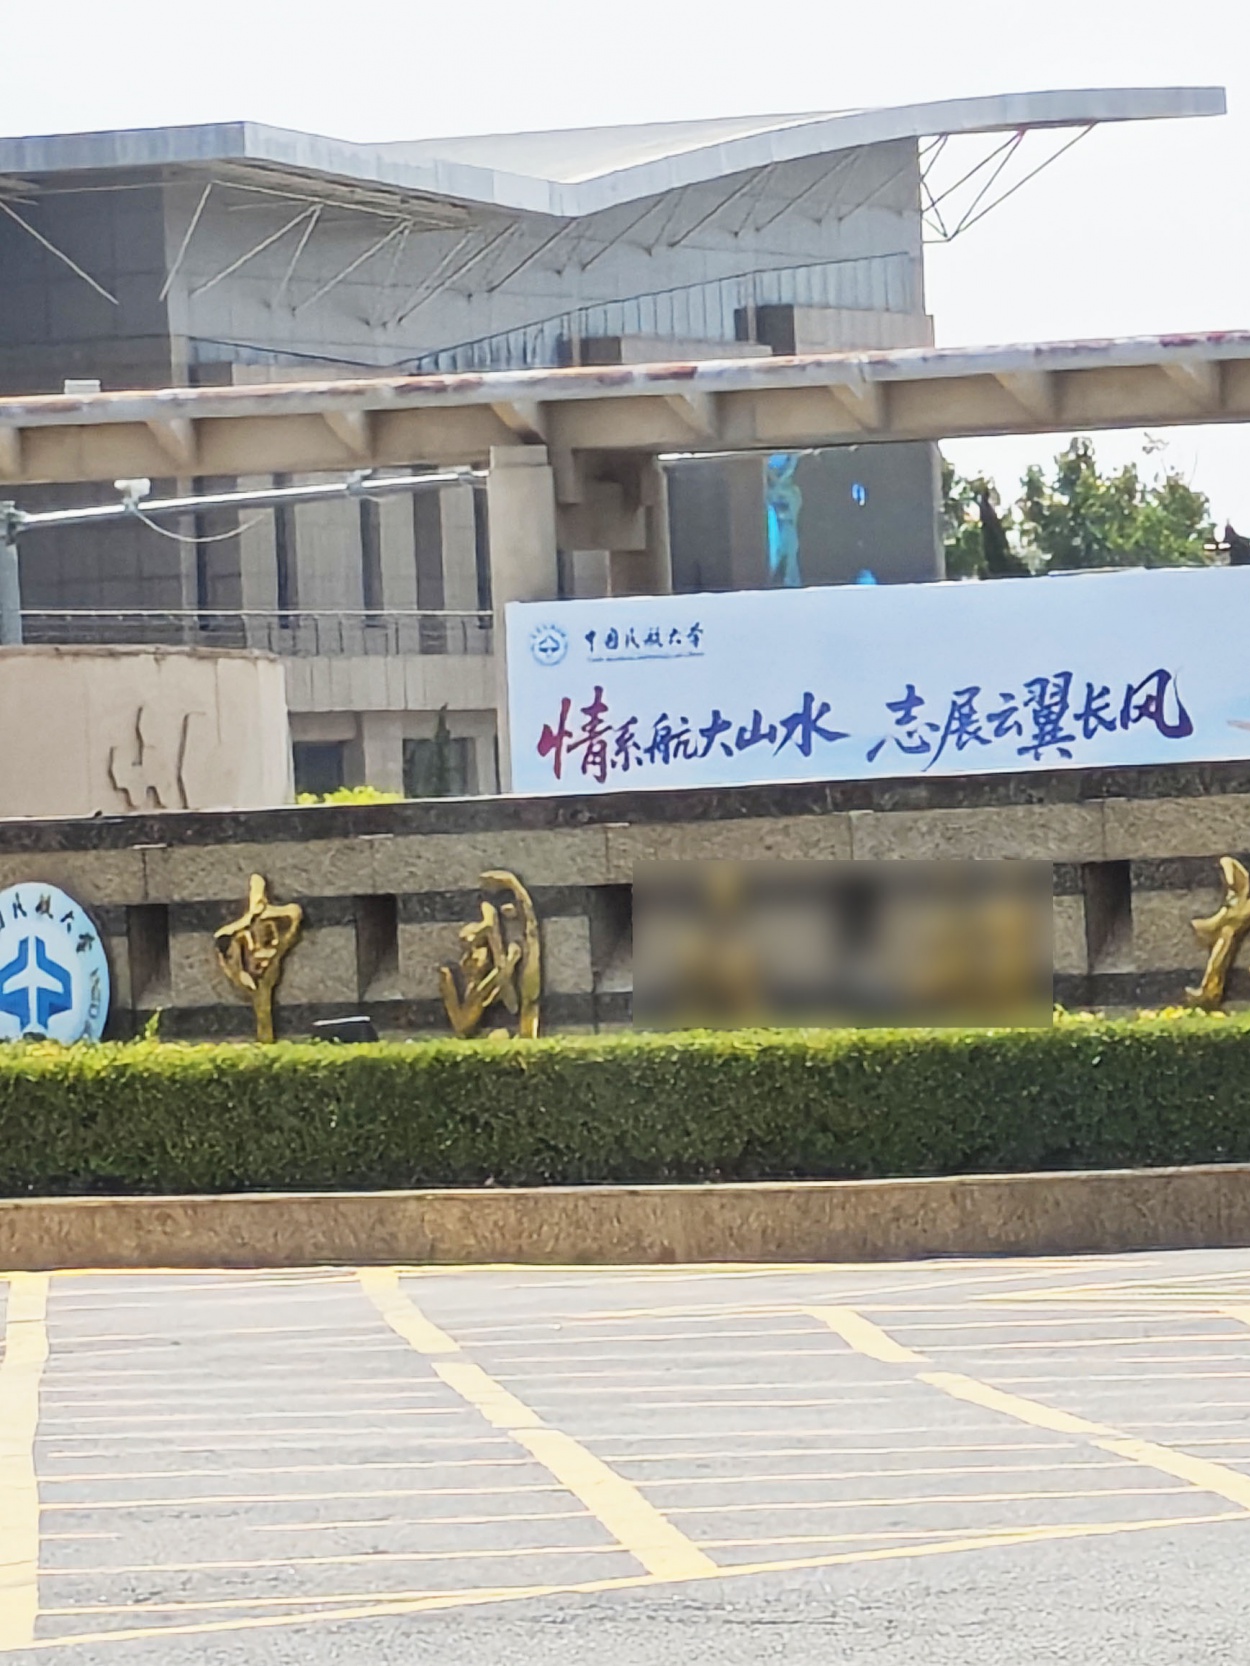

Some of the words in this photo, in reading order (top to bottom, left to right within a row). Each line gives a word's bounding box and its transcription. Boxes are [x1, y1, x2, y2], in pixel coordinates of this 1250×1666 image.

[536, 685, 849, 783] 情系航大山水
[867, 668, 1194, 772] 志展云翼长风
